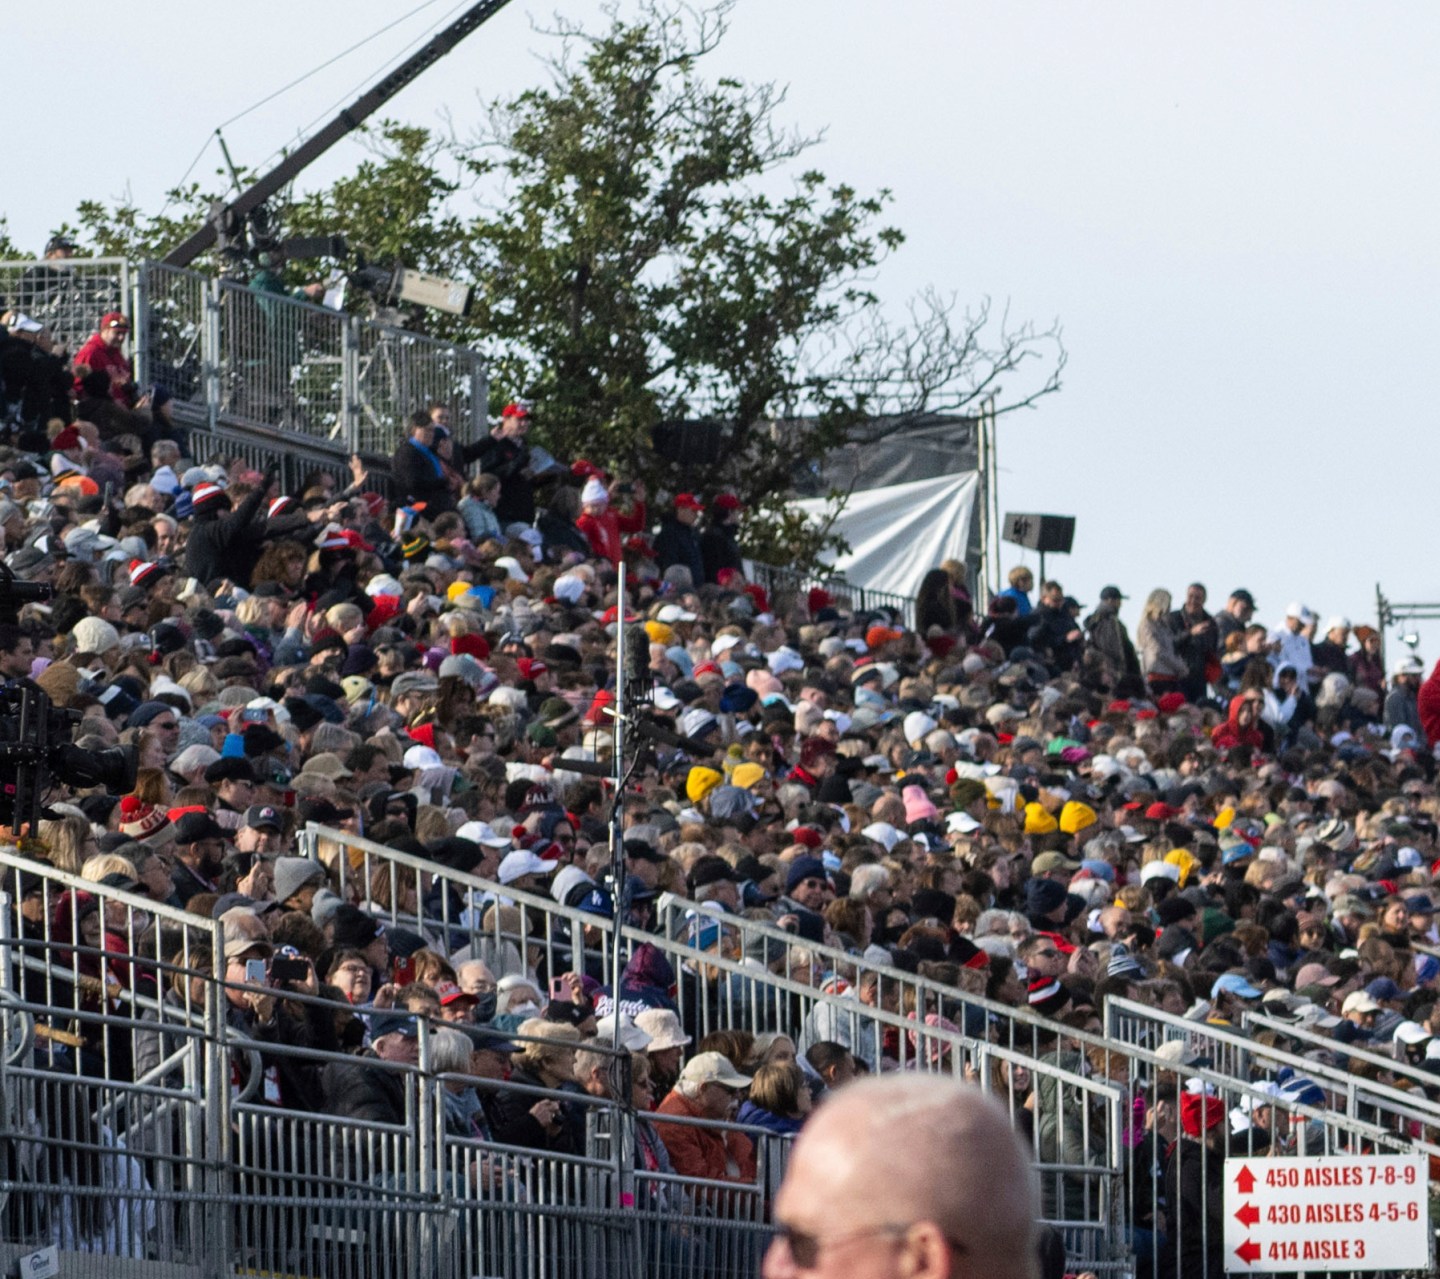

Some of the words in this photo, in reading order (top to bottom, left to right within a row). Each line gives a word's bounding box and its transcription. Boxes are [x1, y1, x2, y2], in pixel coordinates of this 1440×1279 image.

[1266, 1168, 1299, 1188] 450
[1304, 1166, 1363, 1187] AISLES
[1369, 1166, 1416, 1185] 7-8-9
[1267, 1204, 1301, 1224] 430
[1305, 1203, 1364, 1223] AISLES
[1369, 1201, 1419, 1221] 4-5-6
[1268, 1241, 1298, 1261] 414
[1303, 1240, 1350, 1260] AISLE
[1354, 1239, 1366, 1258] 3
